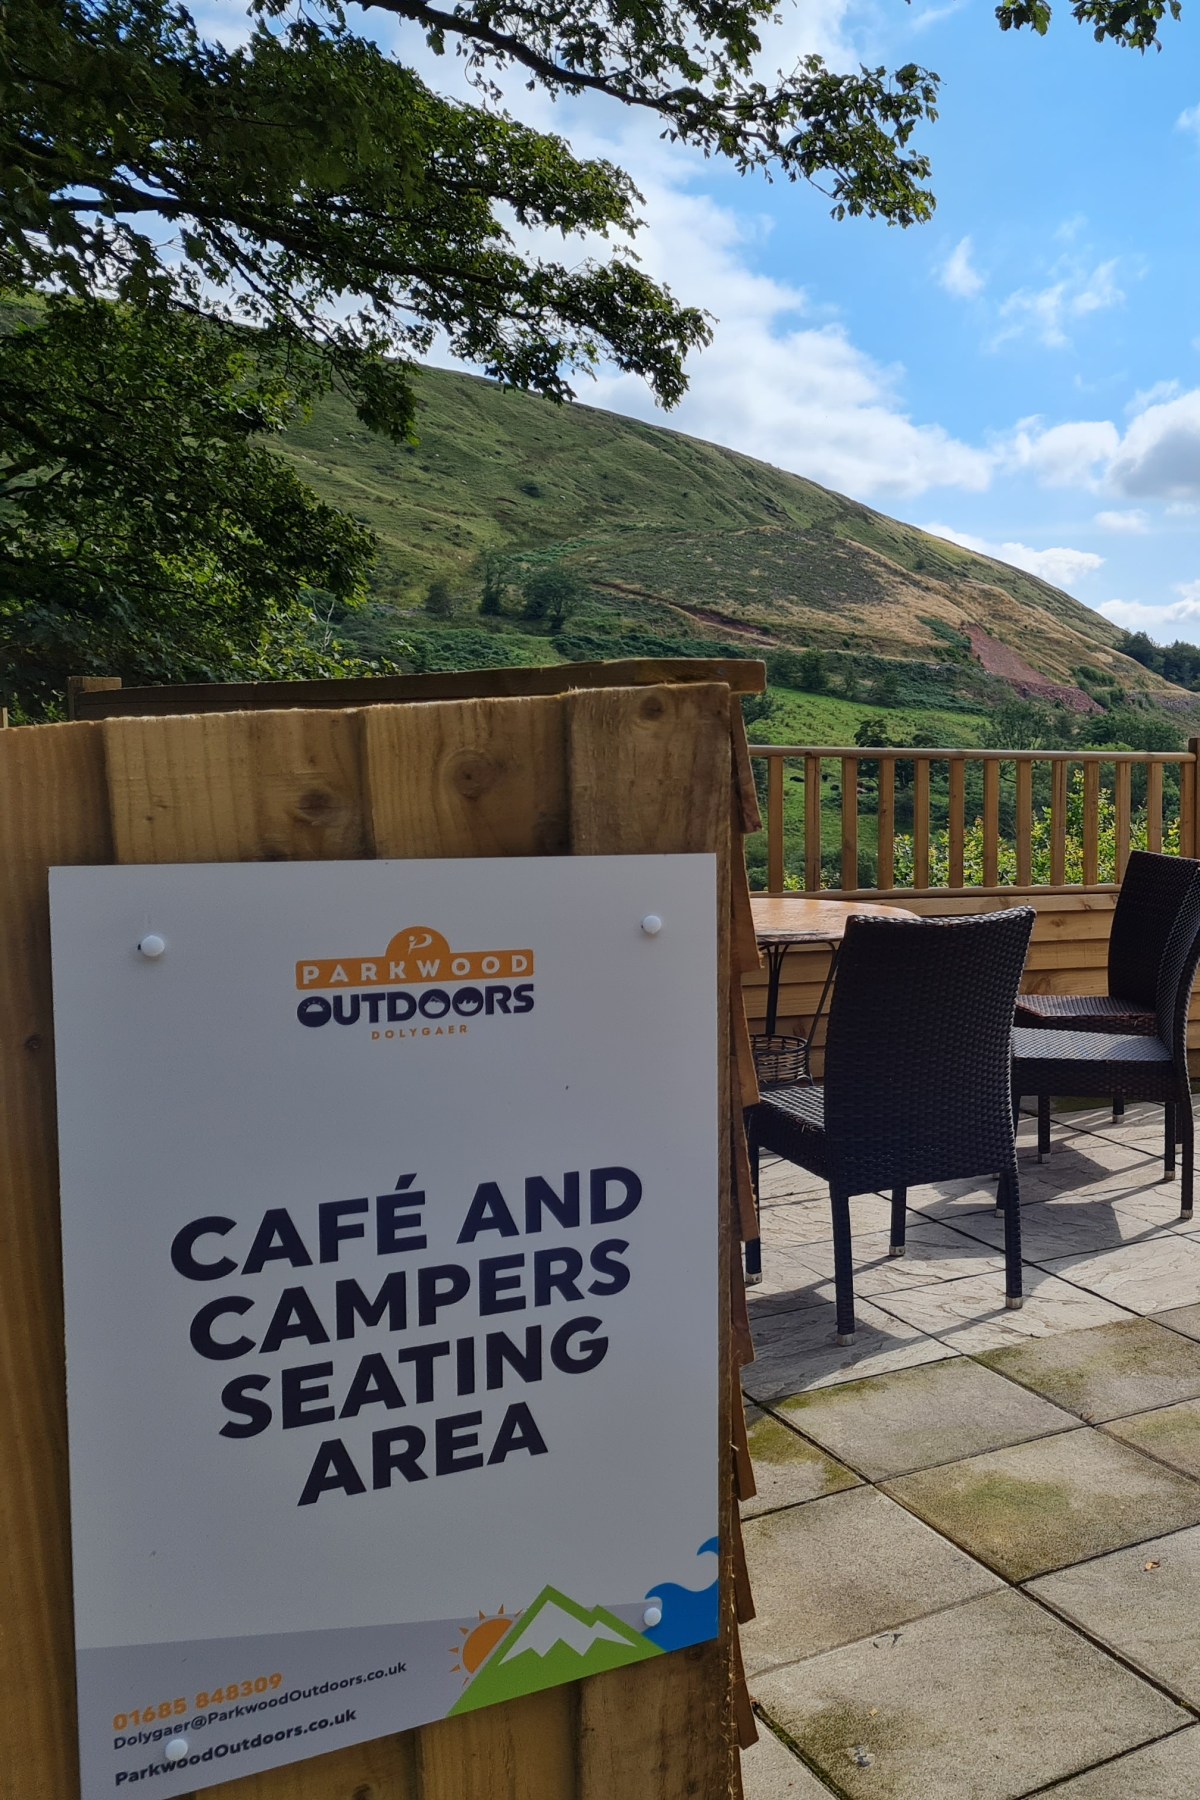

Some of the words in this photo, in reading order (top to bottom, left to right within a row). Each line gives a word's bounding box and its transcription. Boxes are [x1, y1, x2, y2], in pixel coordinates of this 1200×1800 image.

[296, 983, 535, 1028] OUTDOORS
[304, 954, 528, 984] PARKWOOD
[371, 1025, 468, 1040] DOLYGAER
[170, 1172, 428, 1282] CAFÉ
[456, 1165, 643, 1244] AND
[189, 1238, 631, 1361] CAMPERS
[218, 1315, 609, 1440] SEATING
[296, 1401, 549, 1507] AREA
[113, 1660, 408, 1751] Dolygaer@ParkwoodOutdoors.co.uk
[114, 1696, 187, 1731] 01685
[195, 1673, 283, 1709] 848309
[115, 1707, 357, 1787] ParkwoodOutdoors.co.uk
